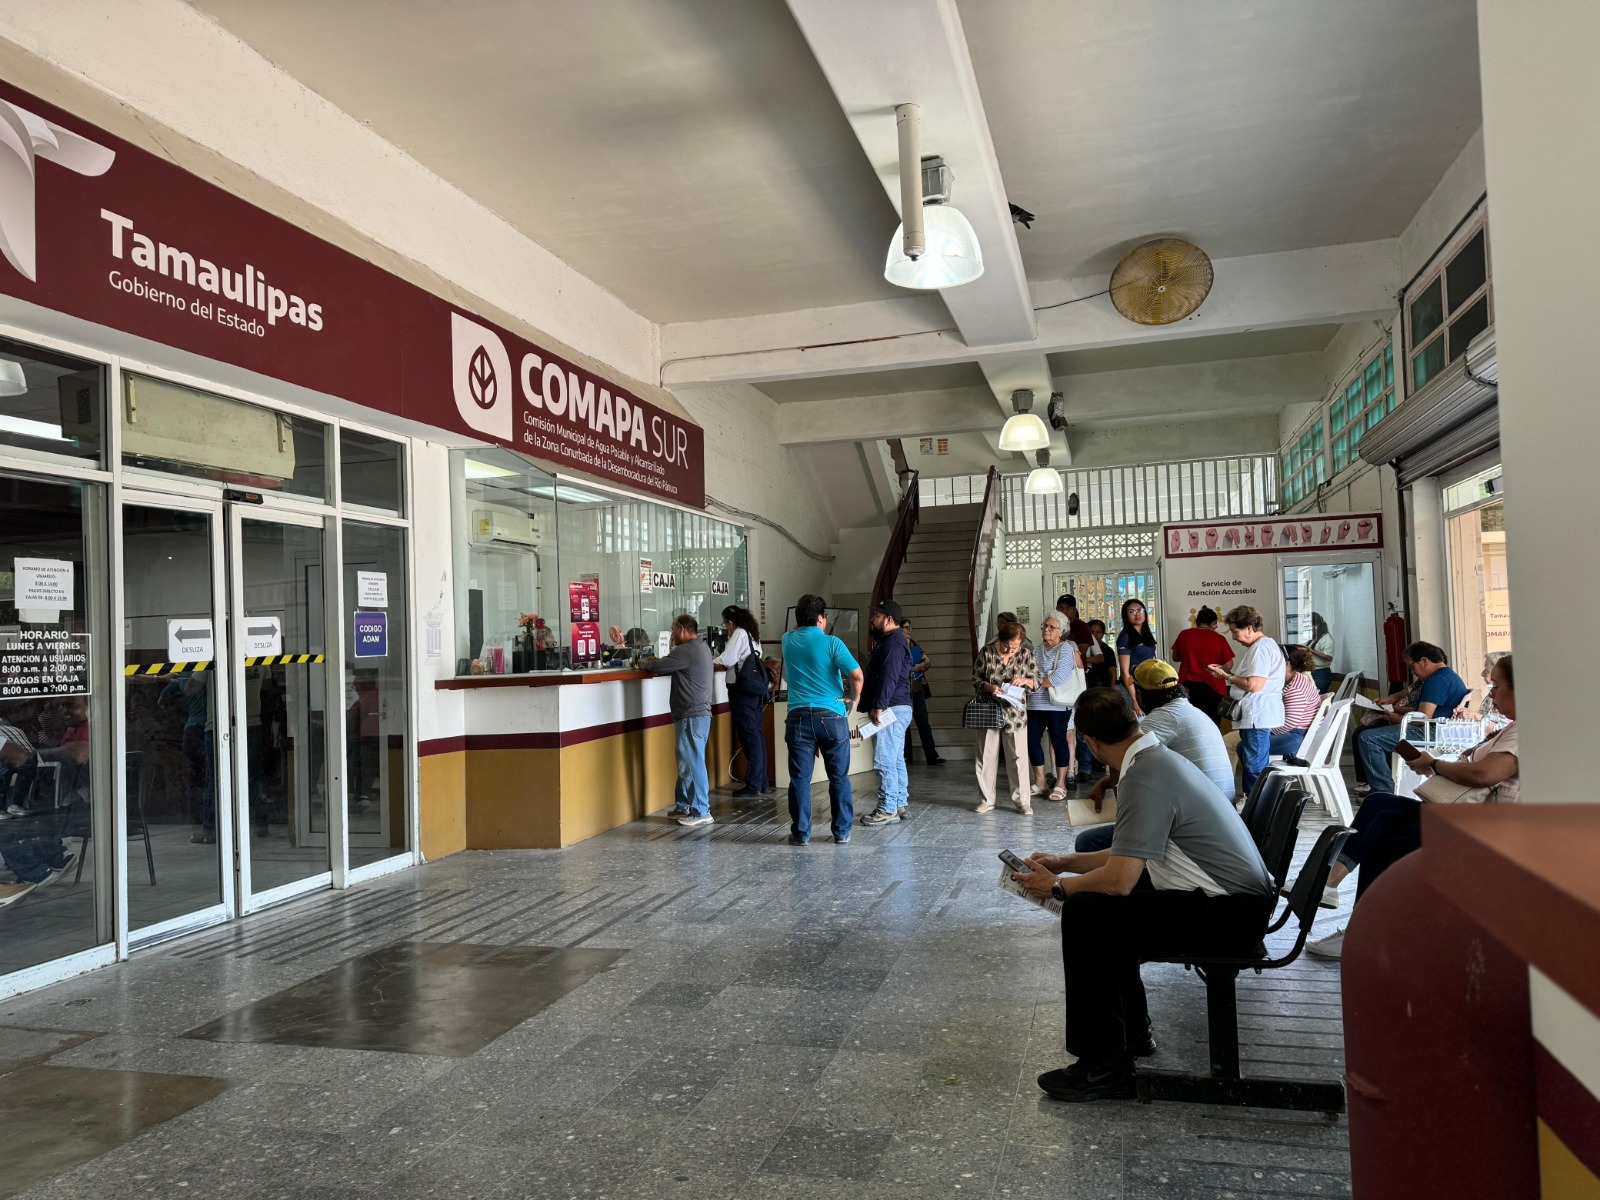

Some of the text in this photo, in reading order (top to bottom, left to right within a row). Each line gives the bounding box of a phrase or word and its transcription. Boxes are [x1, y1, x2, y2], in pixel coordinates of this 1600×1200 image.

[101, 207, 323, 331] Tamaulipas
[109, 270, 265, 337] Gobierno del Estado
[521, 352, 689, 470] COMAPA SUR
[523, 411, 665, 476] Comisión Municipal de Agua Potable y Alcantarillado
[524, 429, 533, 444] de
[534, 432, 540, 446] la
[542, 436, 560, 452] Zona
[560, 442, 593, 464] Conurbada
[594, 454, 600, 467] de
[602, 456, 606, 468] la
[608, 460, 646, 483] Desembocadura
[661, 480, 678, 494] Pánuco
[653, 573, 675, 588] CAJA
[712, 582, 728, 595] CAJA
[20, 631, 69, 639] HORARIO
[360, 624, 382, 633] CODIGO
[2, 655, 40, 663] ATENCION
[2, 665, 20, 673] 8:00
[8, 676, 39, 684] PAGOS
[3, 686, 21, 695] 8:00
